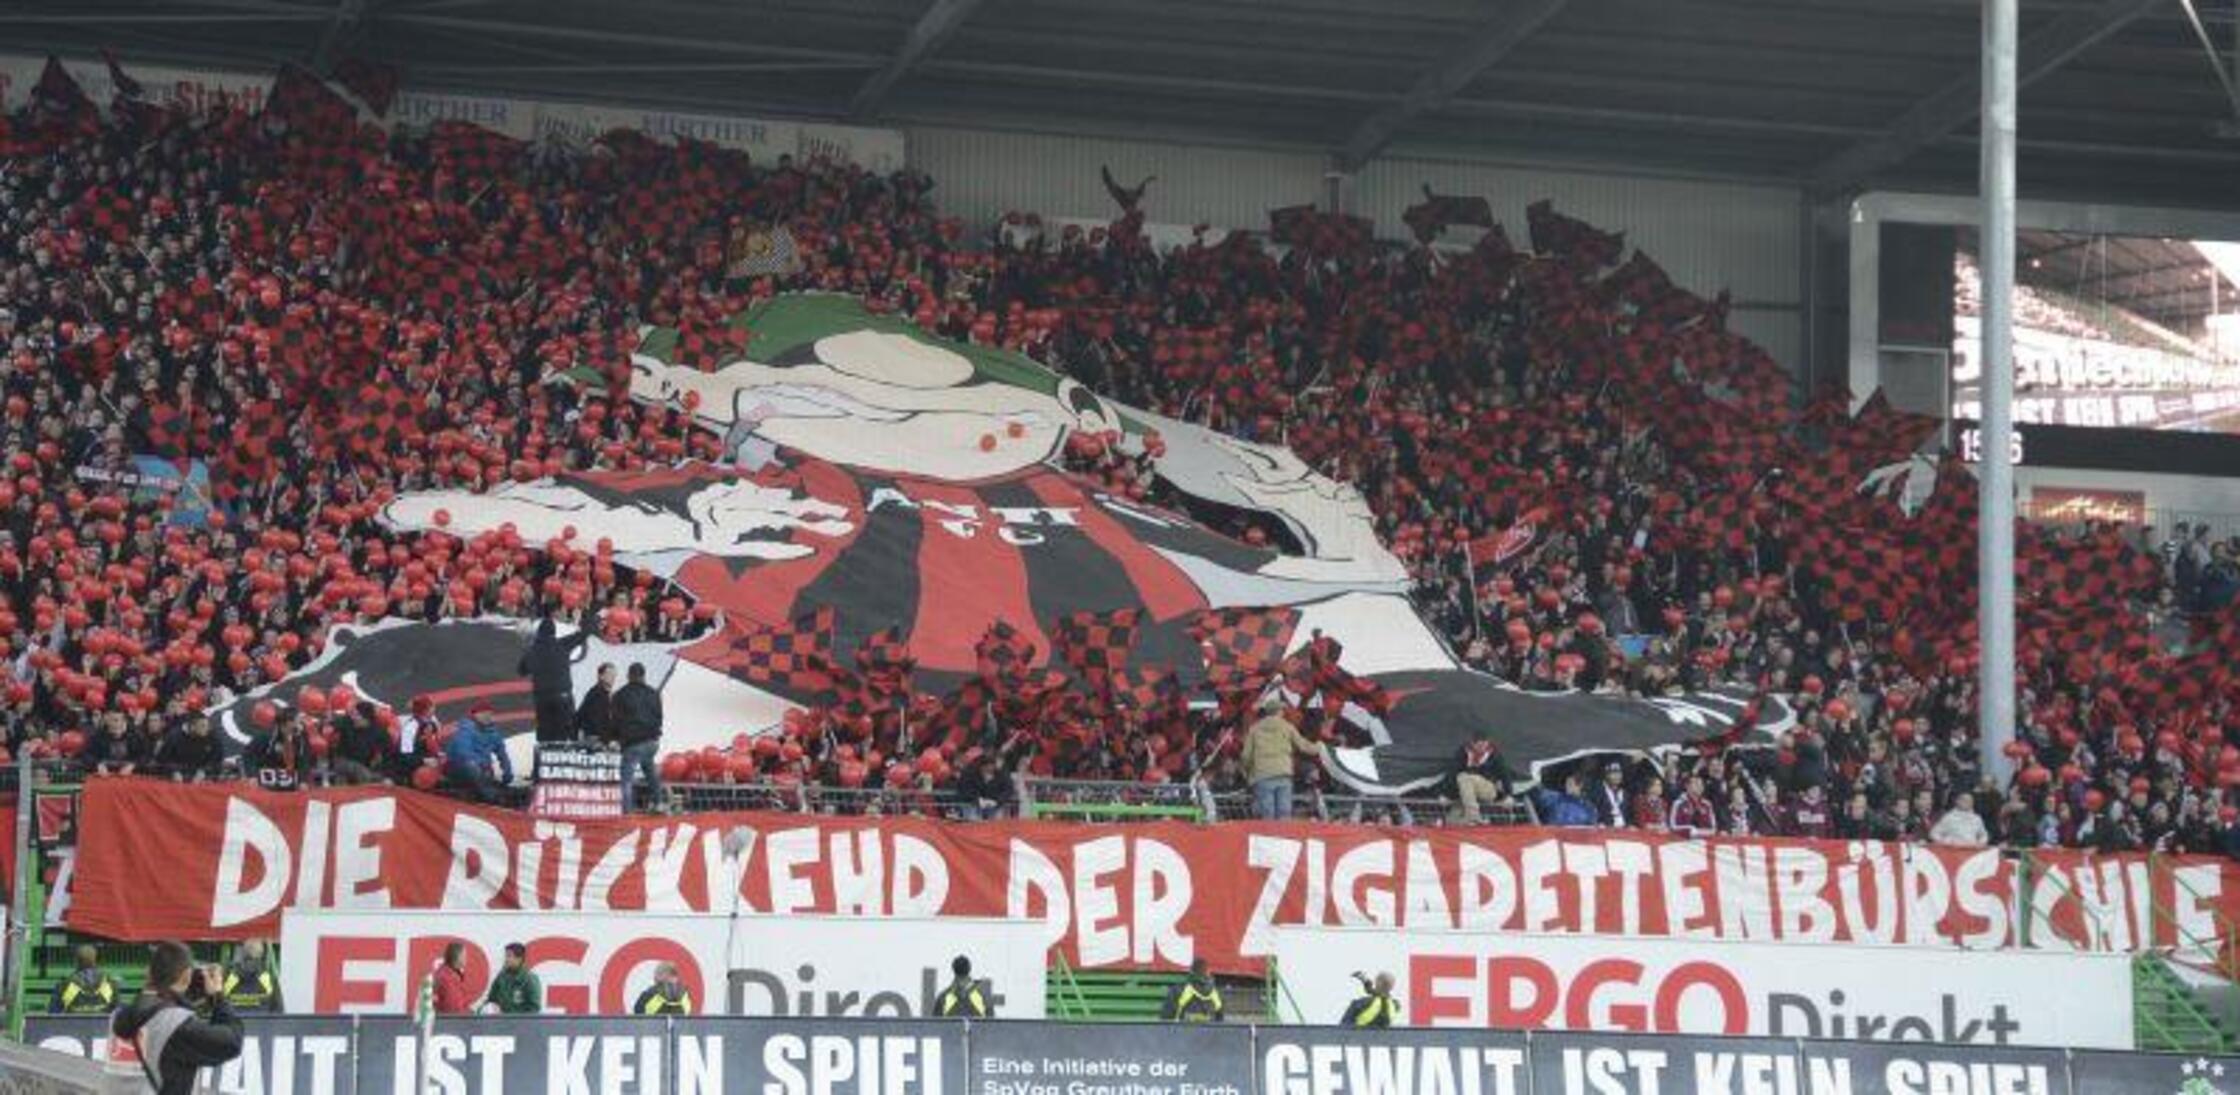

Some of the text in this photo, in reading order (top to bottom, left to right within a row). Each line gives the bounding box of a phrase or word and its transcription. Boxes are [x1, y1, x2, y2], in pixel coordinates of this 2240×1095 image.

[211, 796, 396, 927] DIE
[440, 813, 950, 918] RÜCKKEHR
[1006, 834, 1195, 966] DER
[314, 936, 705, 1014] ERGO
[1409, 954, 1750, 1034] ERGO
[394, 1035, 516, 1095] IST
[547, 1035, 723, 1095] KEIN
[763, 1034, 943, 1095] SPIEL
[982, 1057, 1188, 1077] Eine Initiative der
[1066, 1081, 1172, 1095] Greuther
[1179, 1082, 1240, 1095] Fürth
[1265, 1043, 2049, 1095] GEWALT IST KEIN SPIEL
